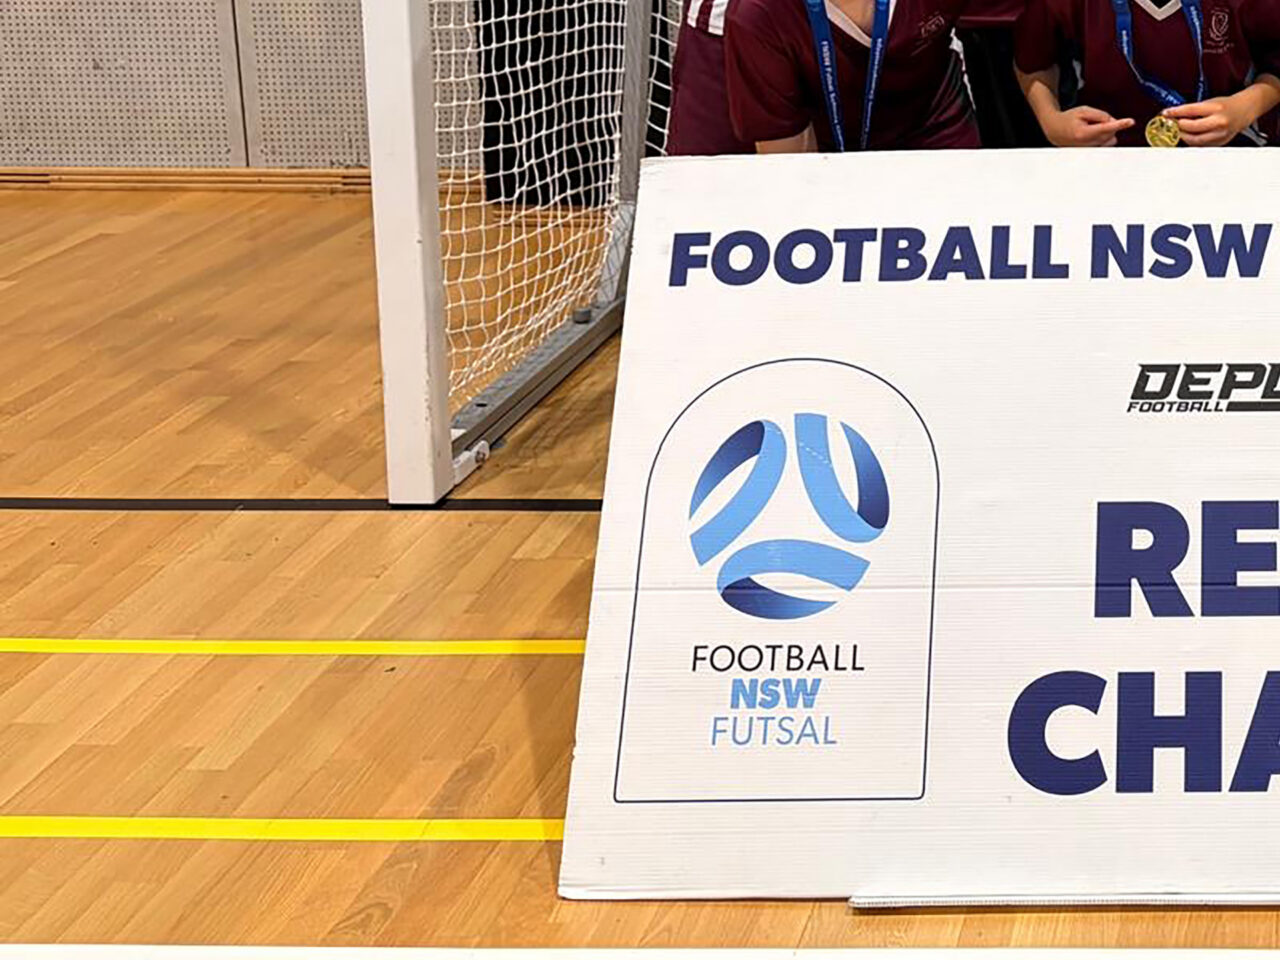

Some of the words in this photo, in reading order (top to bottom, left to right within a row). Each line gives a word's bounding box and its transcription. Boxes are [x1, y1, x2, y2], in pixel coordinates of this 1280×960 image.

[669, 224, 1069, 287] FOOTBALL
[1090, 222, 1273, 280] NSW
[1127, 400, 1224, 413] FOOTBALL
[691, 643, 866, 673] FOOTBALL
[730, 677, 822, 710] NSW
[711, 715, 838, 746] FUTSAL
